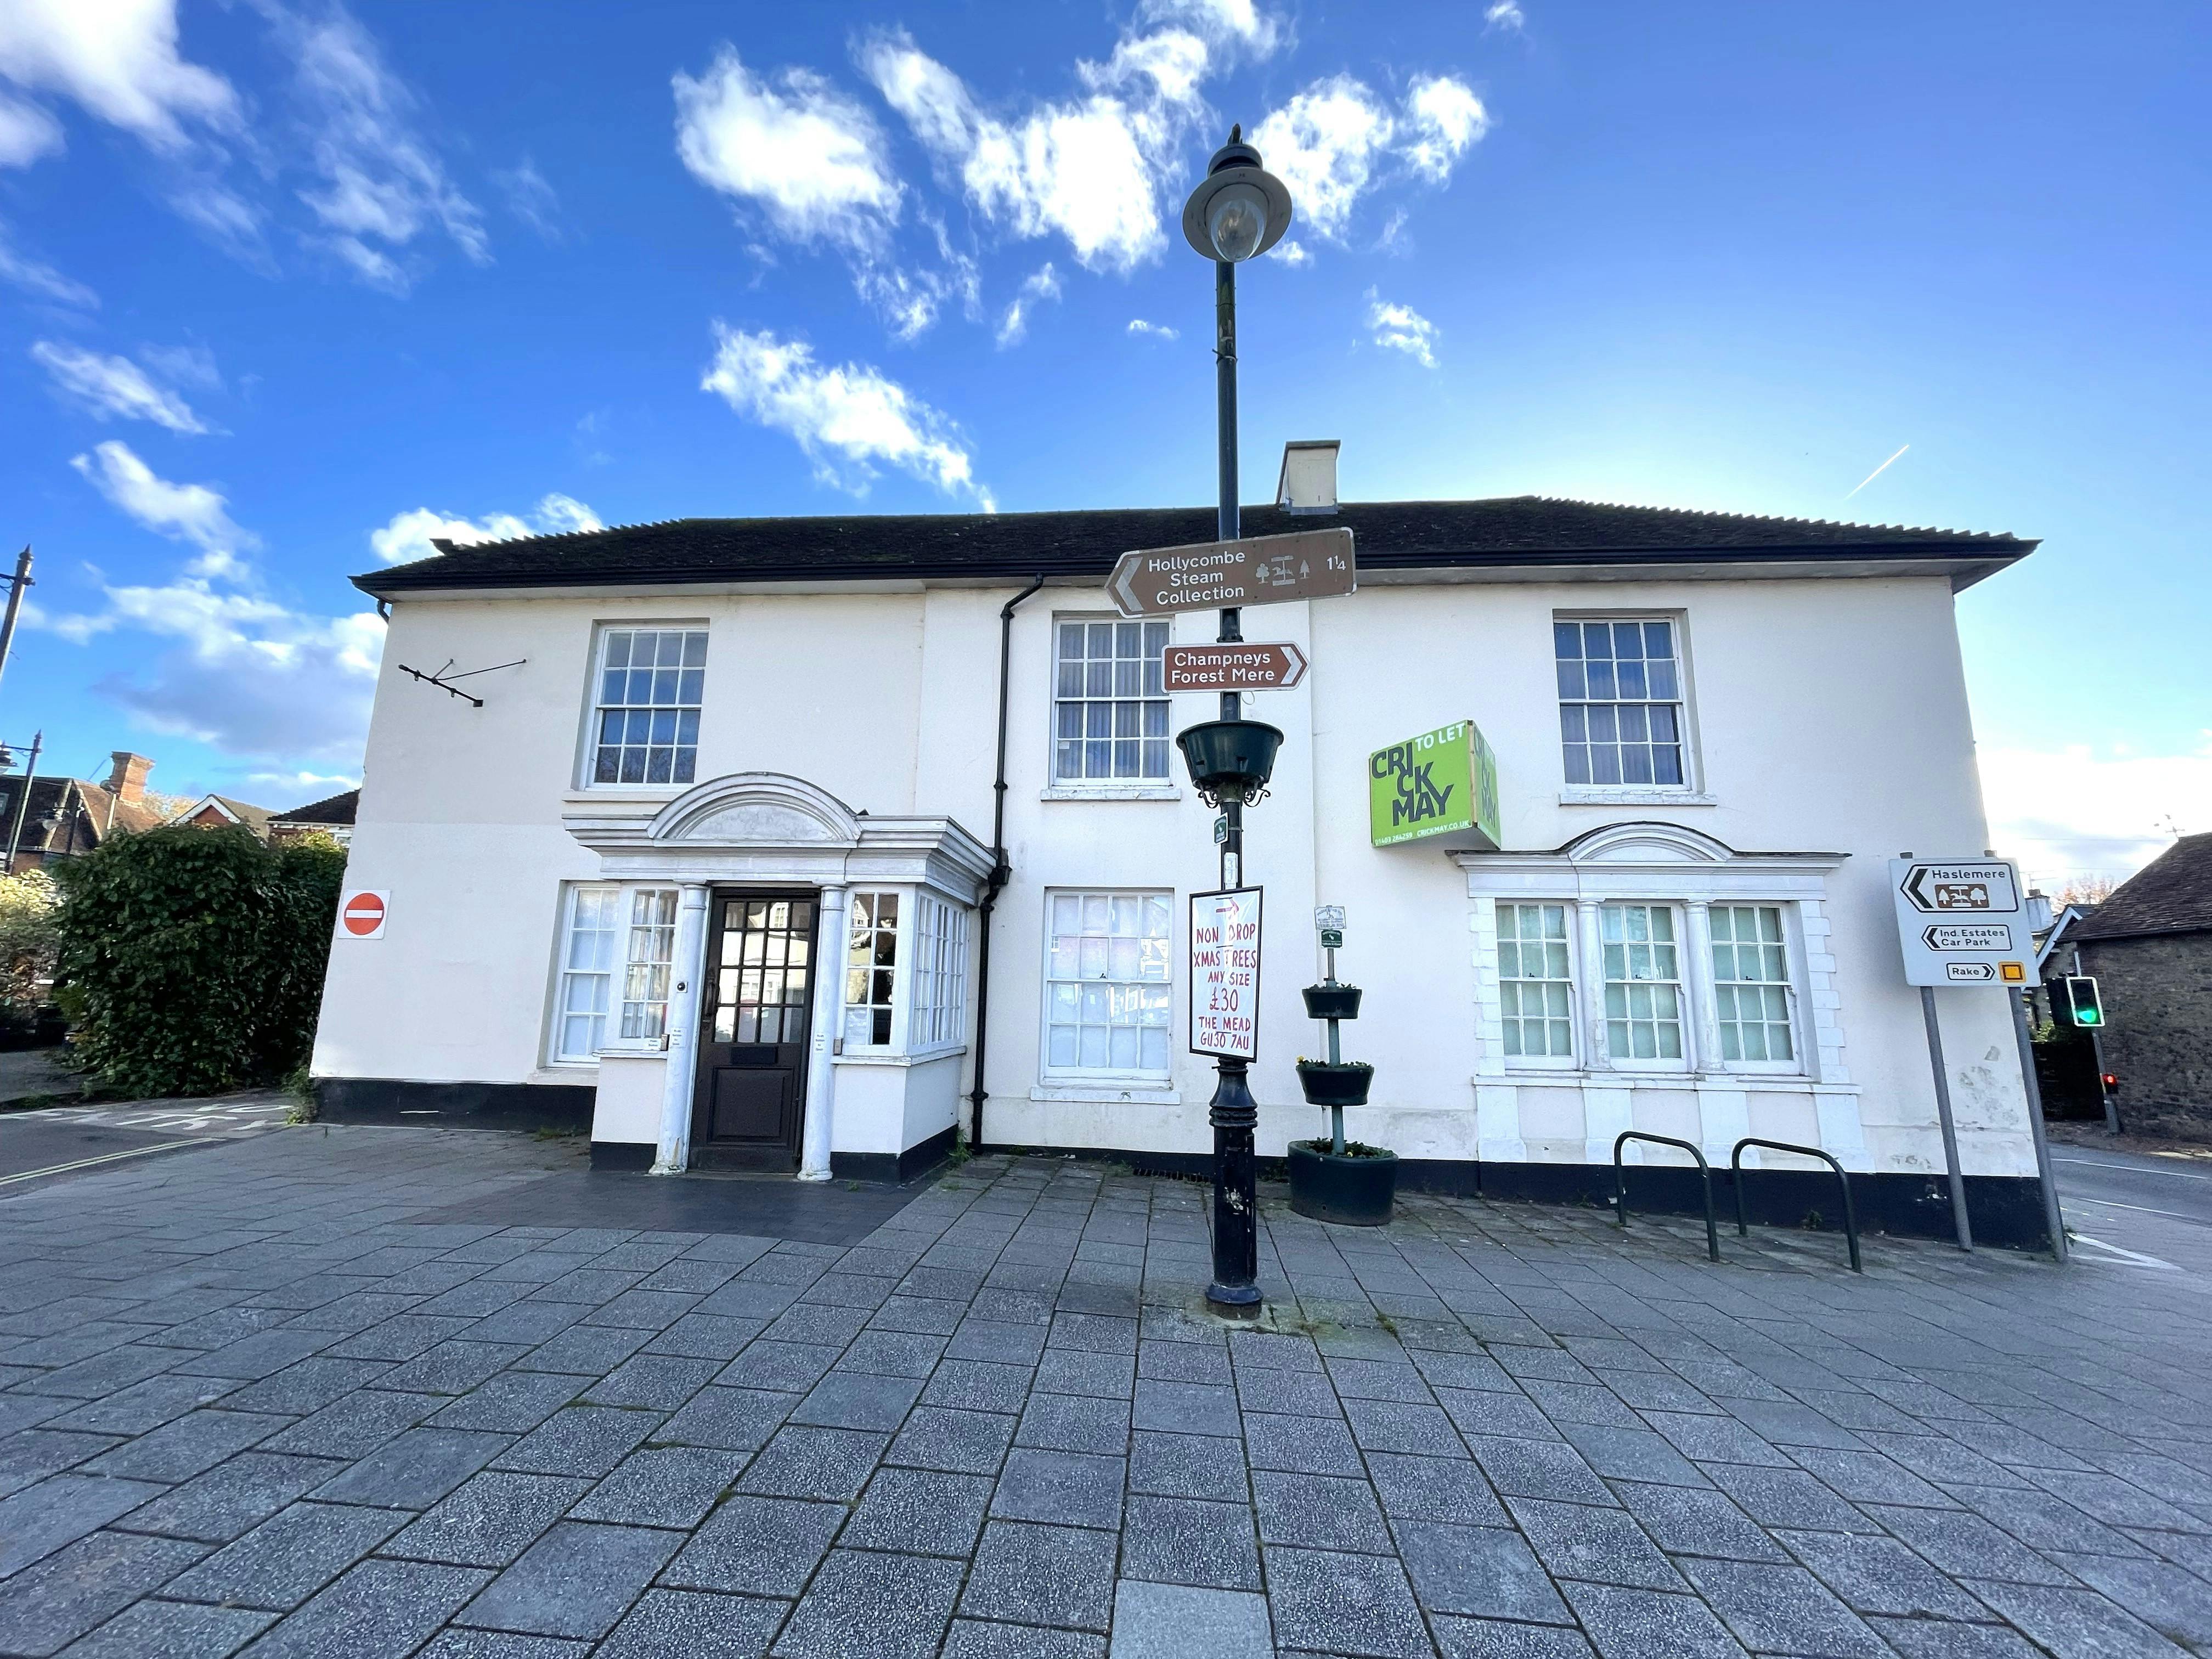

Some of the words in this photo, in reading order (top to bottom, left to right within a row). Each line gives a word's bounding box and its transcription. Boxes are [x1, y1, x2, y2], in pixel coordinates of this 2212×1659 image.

[1148, 551, 1245, 572] Hollycombe
[1170, 572, 1223, 586] Steam
[1156, 586, 1244, 605] Collection
[1174, 652, 1271, 667] Champneys
[1171, 669, 1225, 684] Forest
[1232, 668, 1275, 682] Mere
[1415, 734, 1434, 752] TO
[1438, 723, 1465, 744] LET
[1392, 784, 1454, 826] MAY
[1932, 870, 2006, 878] Haslemere
[1197, 927, 1218, 944] NON
[1229, 923, 1255, 941] DROP
[1194, 951, 1220, 968] XMAS
[1224, 950, 1256, 969] TREES
[1207, 971, 1225, 984] ANY
[1229, 972, 1250, 986] SIZE
[1952, 967, 1979, 975] Rake
[1209, 986, 1238, 1012] £30
[1199, 1016, 1217, 1030] THE
[1223, 1017, 1251, 1032] MEAD
[1200, 1031, 1226, 1049] GU30
[1231, 1034, 1249, 1050] 7AU
